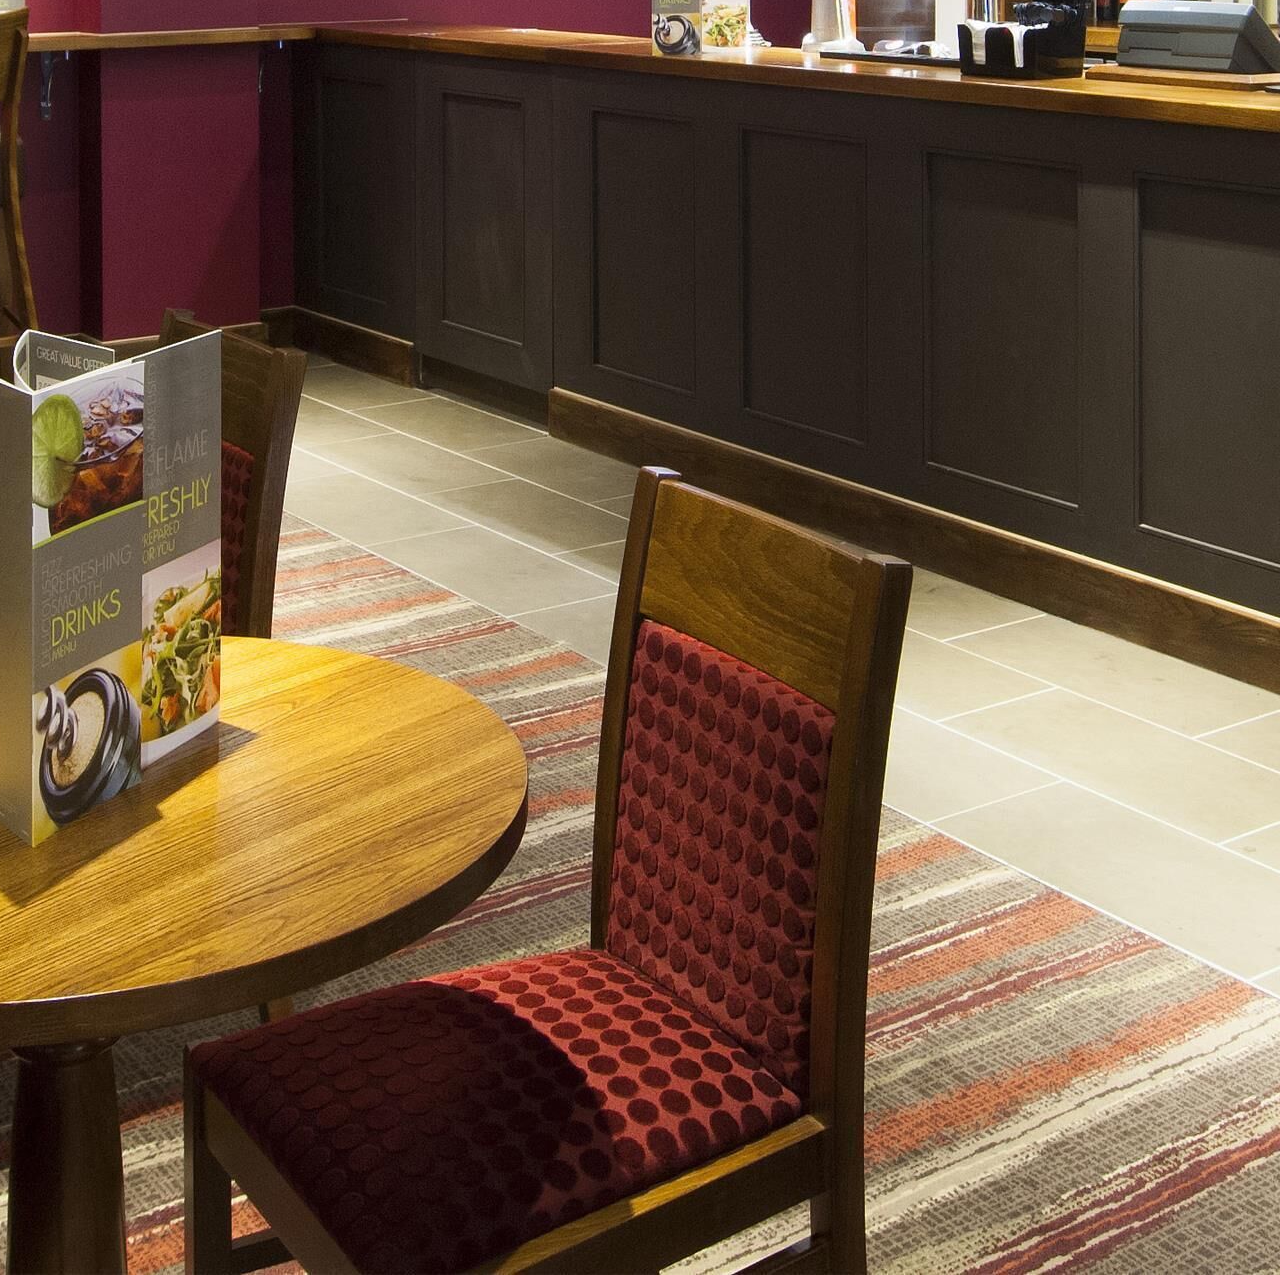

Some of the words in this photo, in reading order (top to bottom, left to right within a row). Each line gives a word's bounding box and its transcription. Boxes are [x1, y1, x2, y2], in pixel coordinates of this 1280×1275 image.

[37, 346, 59, 363] GREAT
[60, 352, 82, 370] VALUE
[156, 428, 209, 475] FLAME
[144, 473, 211, 528] RESHLY
[142, 520, 180, 547] REPARED
[156, 538, 176, 559] YOU
[51, 545, 132, 596] REFRESHING
[51, 579, 103, 616] SMOOTH
[51, 588, 121, 647] DRINKS
[51, 640, 77, 663] MENU
